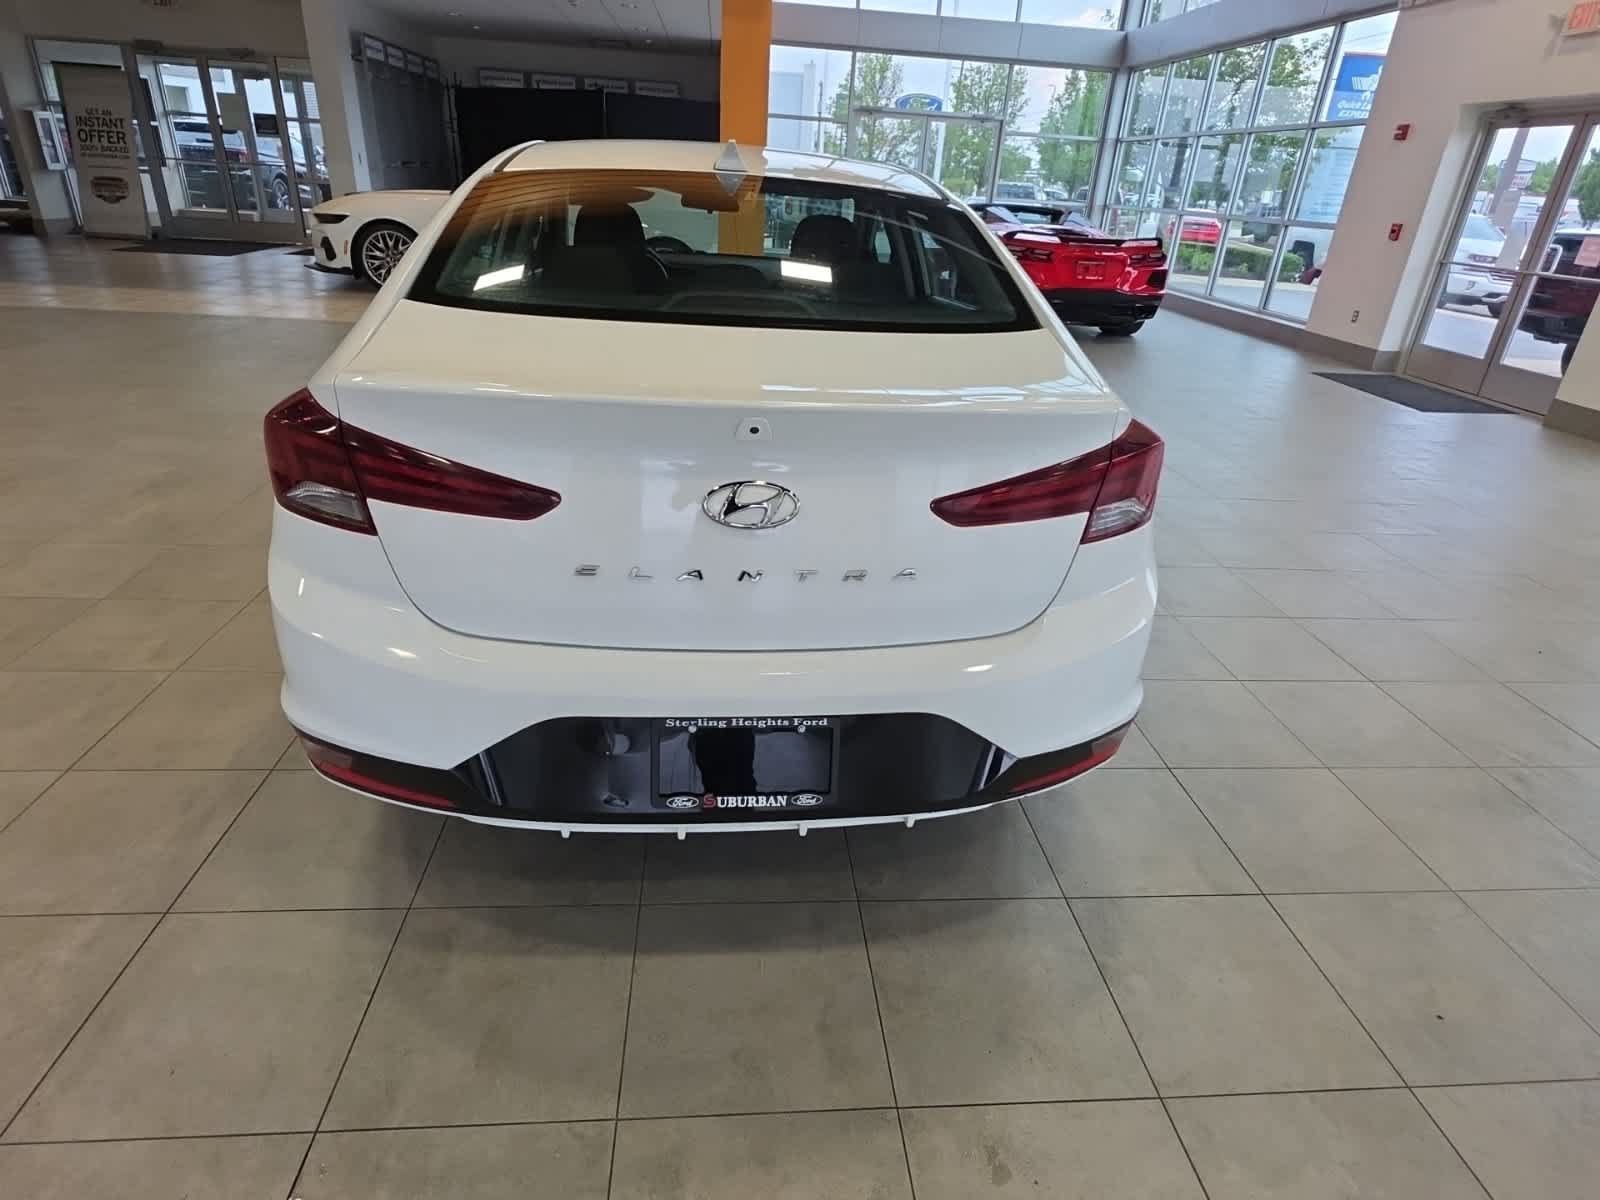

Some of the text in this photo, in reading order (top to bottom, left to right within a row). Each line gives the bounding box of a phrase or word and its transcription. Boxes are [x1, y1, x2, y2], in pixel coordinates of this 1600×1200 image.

[75, 116, 125, 129] INSTANT
[78, 129, 127, 145] OFFER
[574, 564, 918, 582] ELANTRA
[665, 717, 828, 728] Sterling Heights Ford
[669, 794, 821, 808] Ford SUBURBAN Ford
